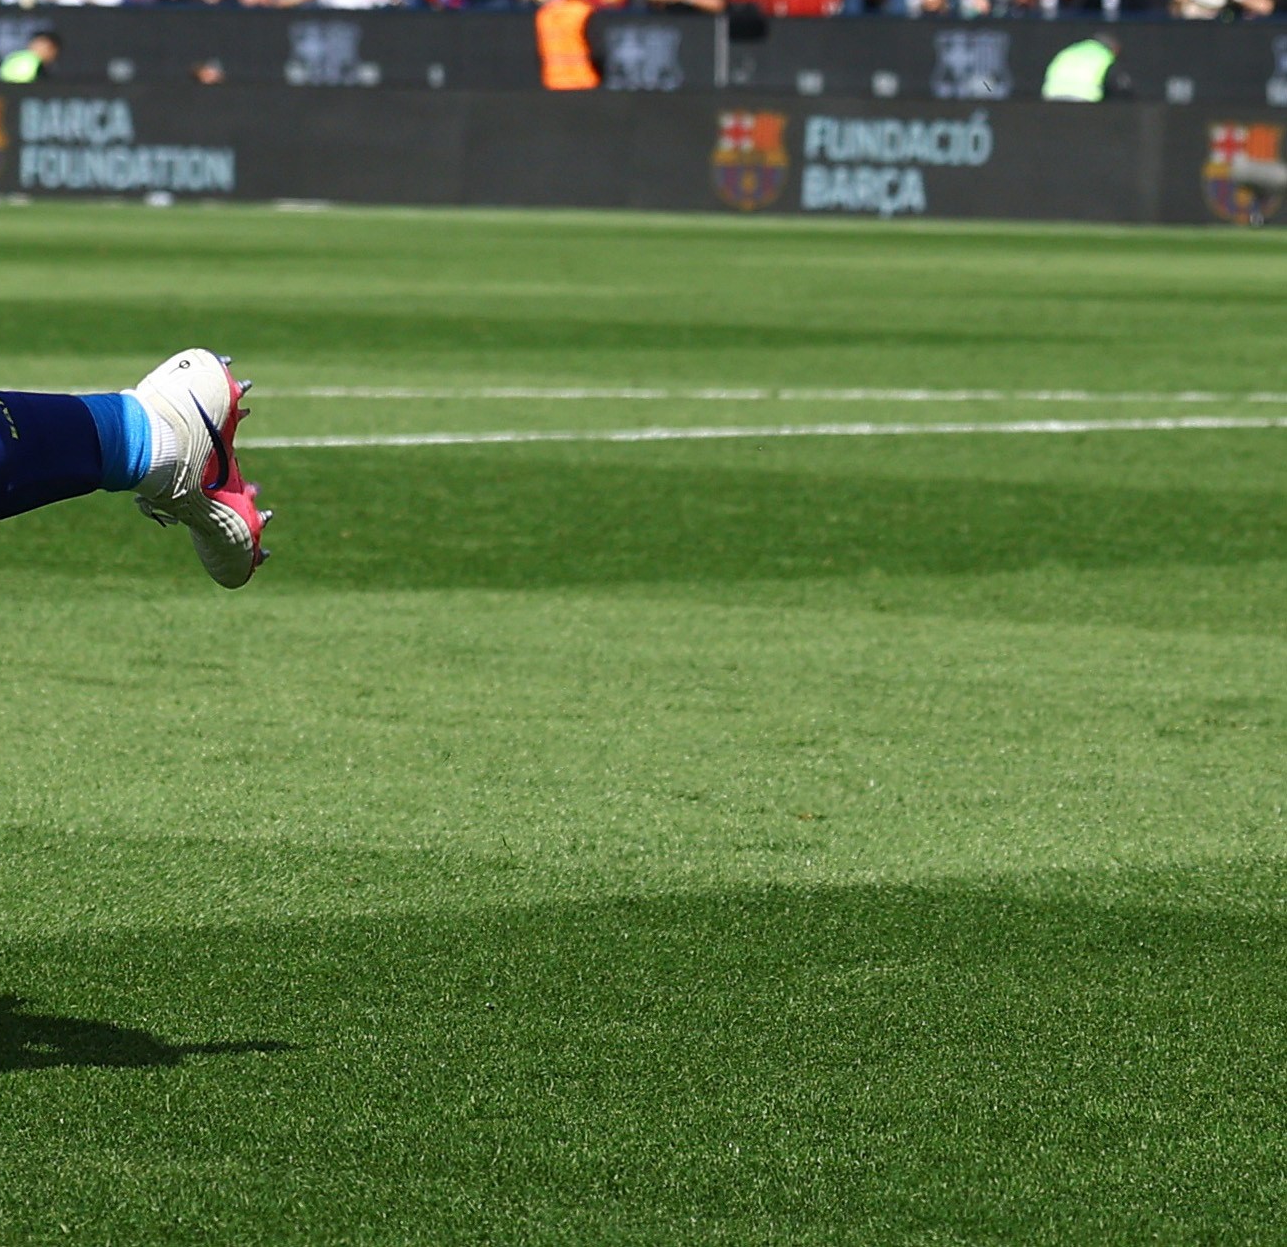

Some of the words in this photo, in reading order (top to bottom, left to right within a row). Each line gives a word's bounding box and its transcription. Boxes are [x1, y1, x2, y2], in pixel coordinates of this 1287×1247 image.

[19, 97, 135, 145] BARÇA
[804, 106, 994, 167] FUNDACIÓ
[20, 142, 236, 192] FOUNDATION
[801, 165, 928, 218] BARÇA
